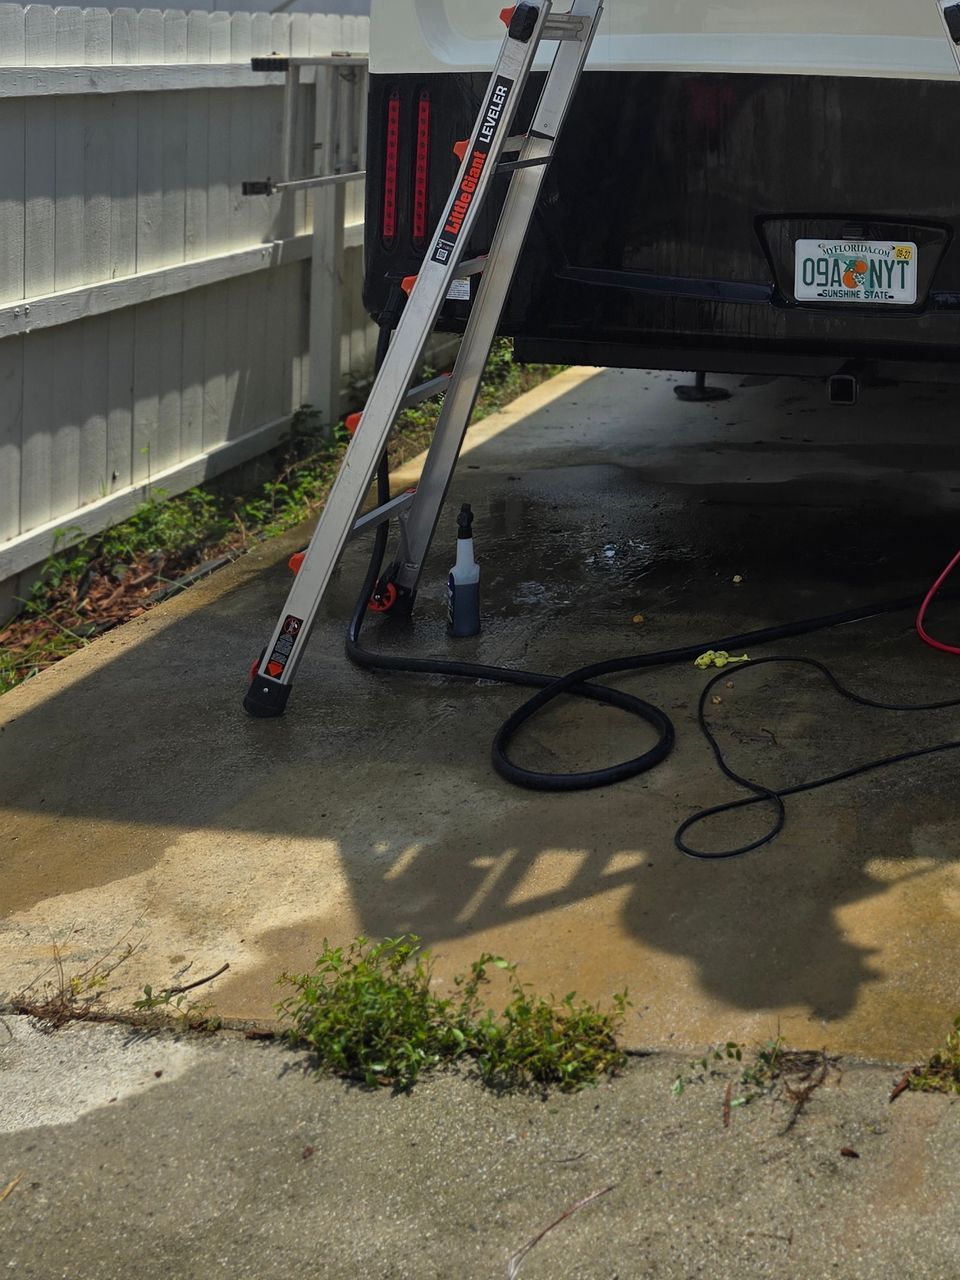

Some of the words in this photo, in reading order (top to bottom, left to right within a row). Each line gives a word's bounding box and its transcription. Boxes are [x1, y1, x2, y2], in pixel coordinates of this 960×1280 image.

[479, 85, 508, 144] LEVELER
[822, 243, 891, 258] MYFLORIDA.COM
[802, 257, 842, 287] 09A
[869, 259, 909, 289] NYT
[822, 289, 861, 299] SUNSHINE
[864, 291, 889, 300] STATE
